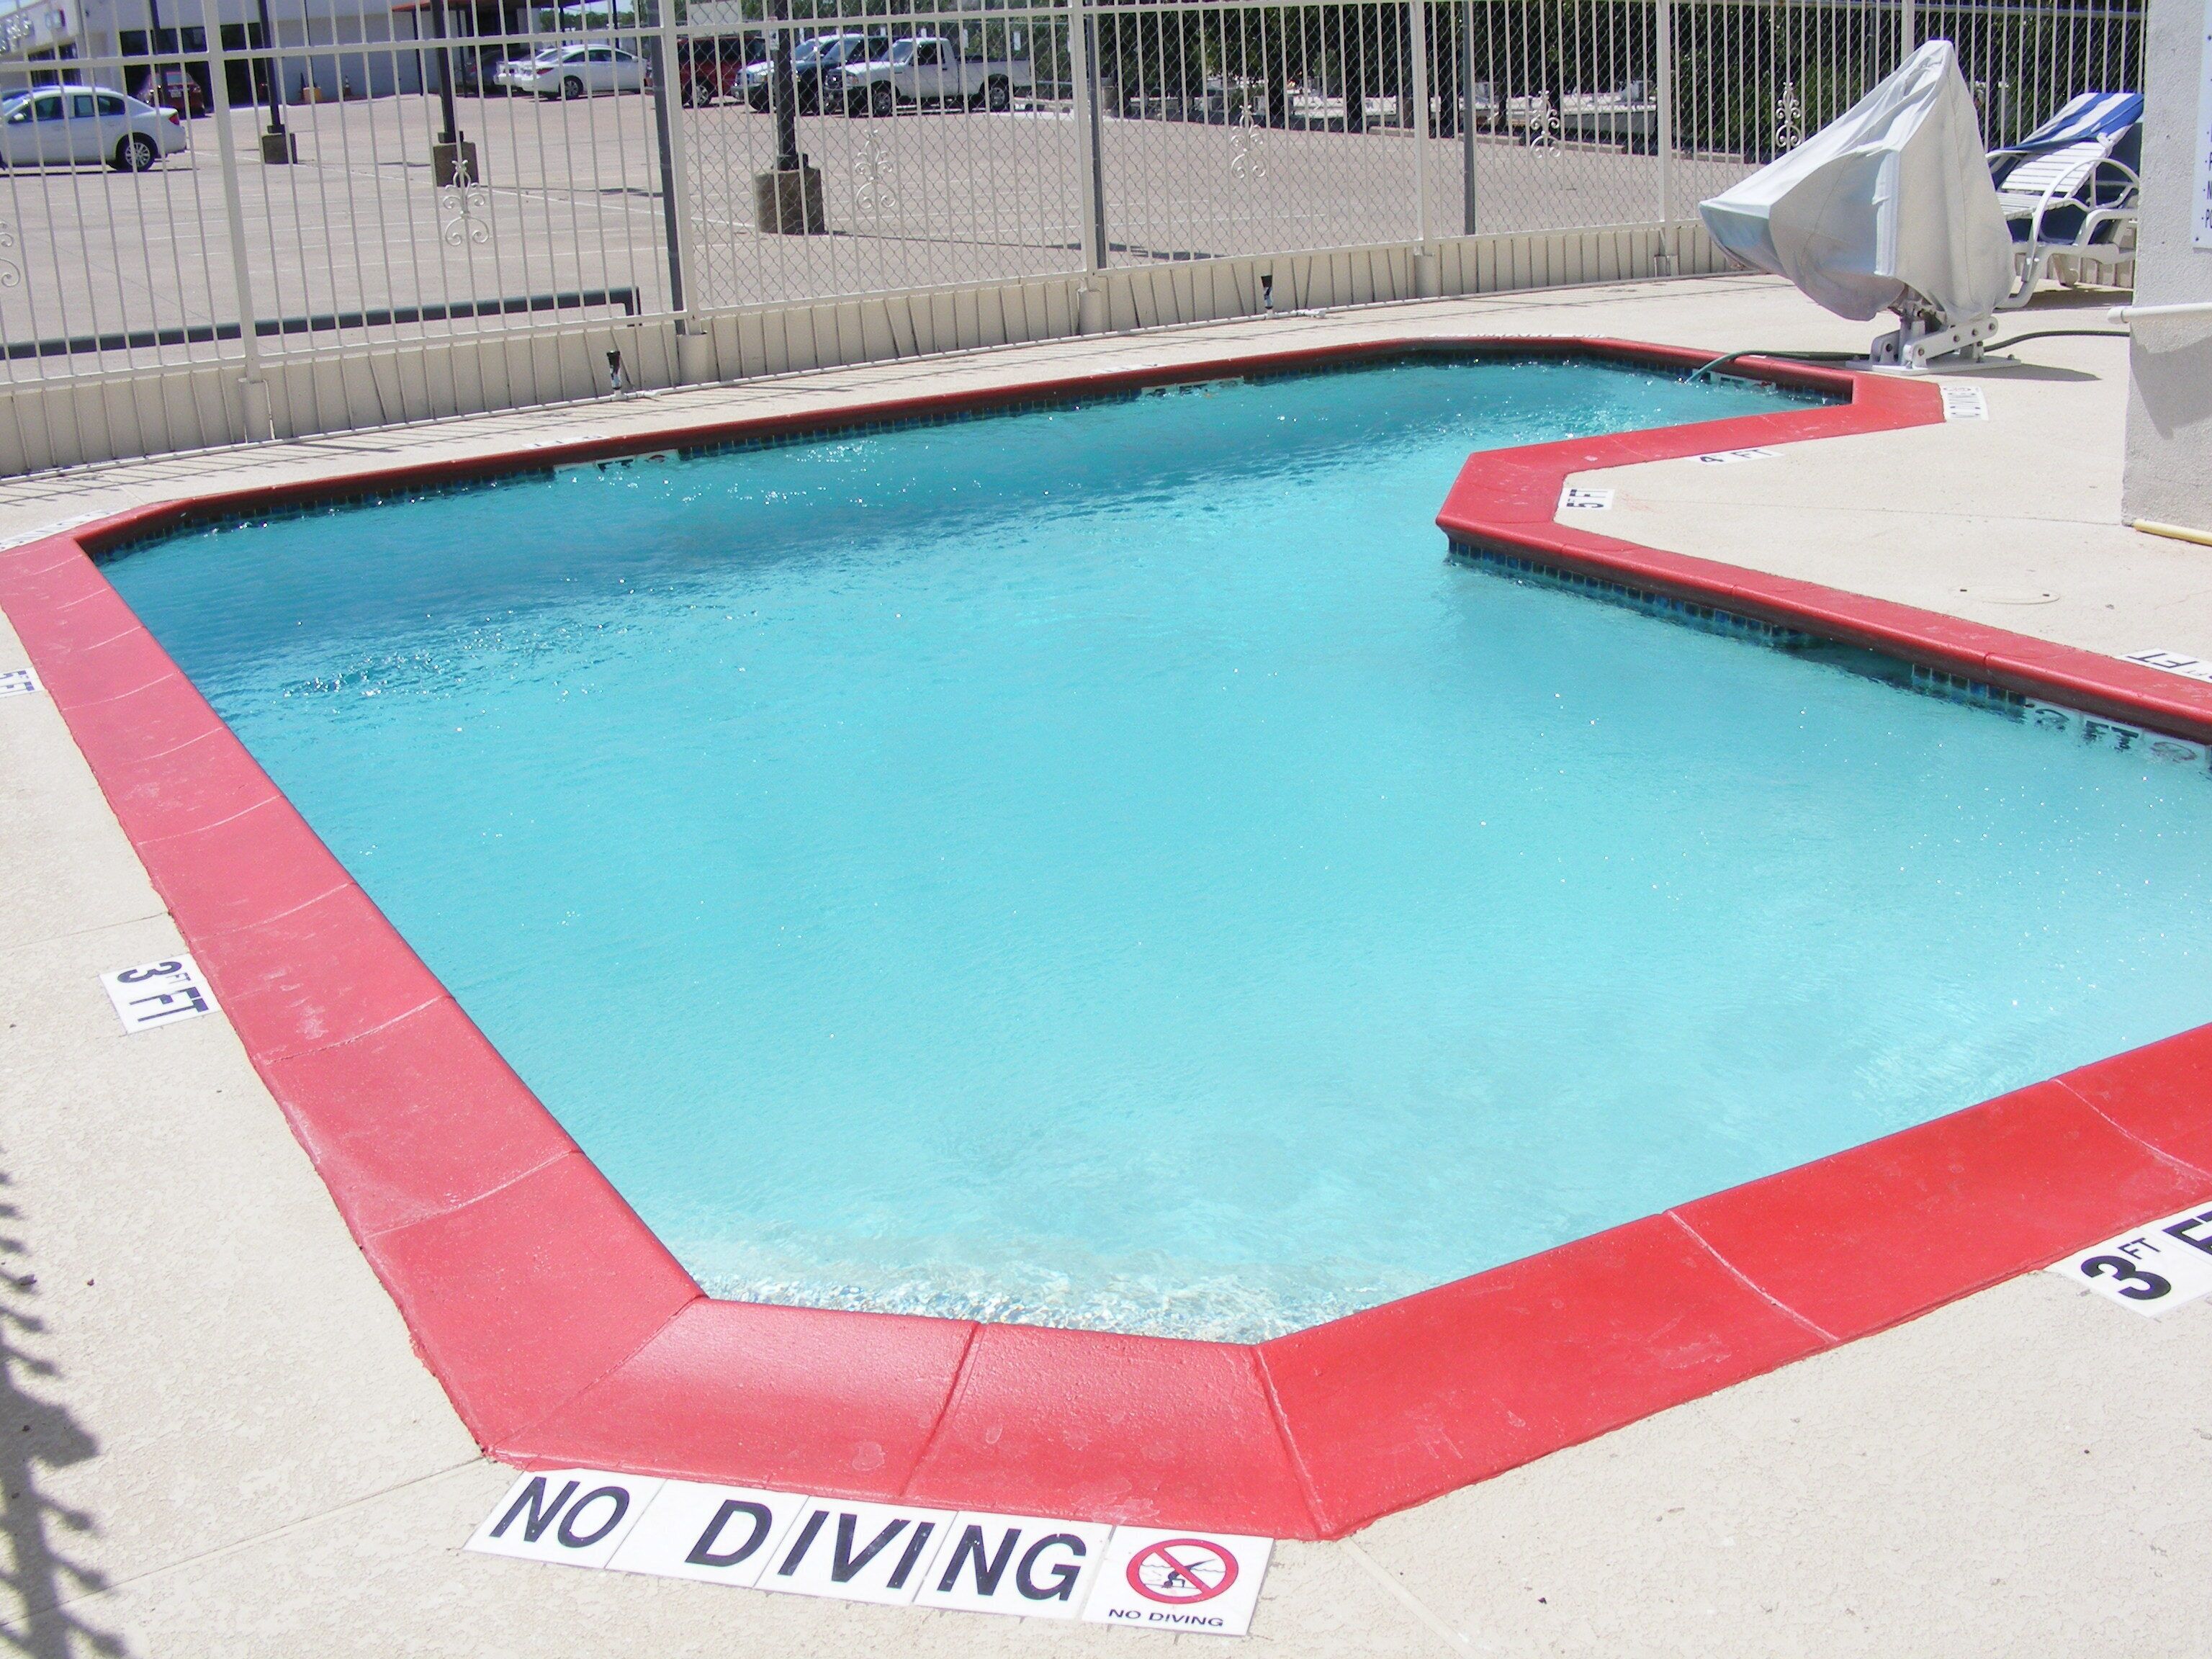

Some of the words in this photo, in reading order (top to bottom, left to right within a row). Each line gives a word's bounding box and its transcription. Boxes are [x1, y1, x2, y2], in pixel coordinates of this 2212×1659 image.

[1730, 449, 1772, 459] FT
[1569, 489, 1609, 498] FT
[2126, 652, 2199, 669] FT
[117, 961, 182, 984] 3
[128, 986, 209, 1022] FT
[2118, 1237, 2161, 1259] FT
[2080, 1255, 2171, 1300] 3
[489, 1476, 630, 1548] NO
[684, 1498, 1087, 1601] DIVING
[1108, 1609, 1141, 1619] NO
[1148, 1612, 1223, 1627] DIVING
